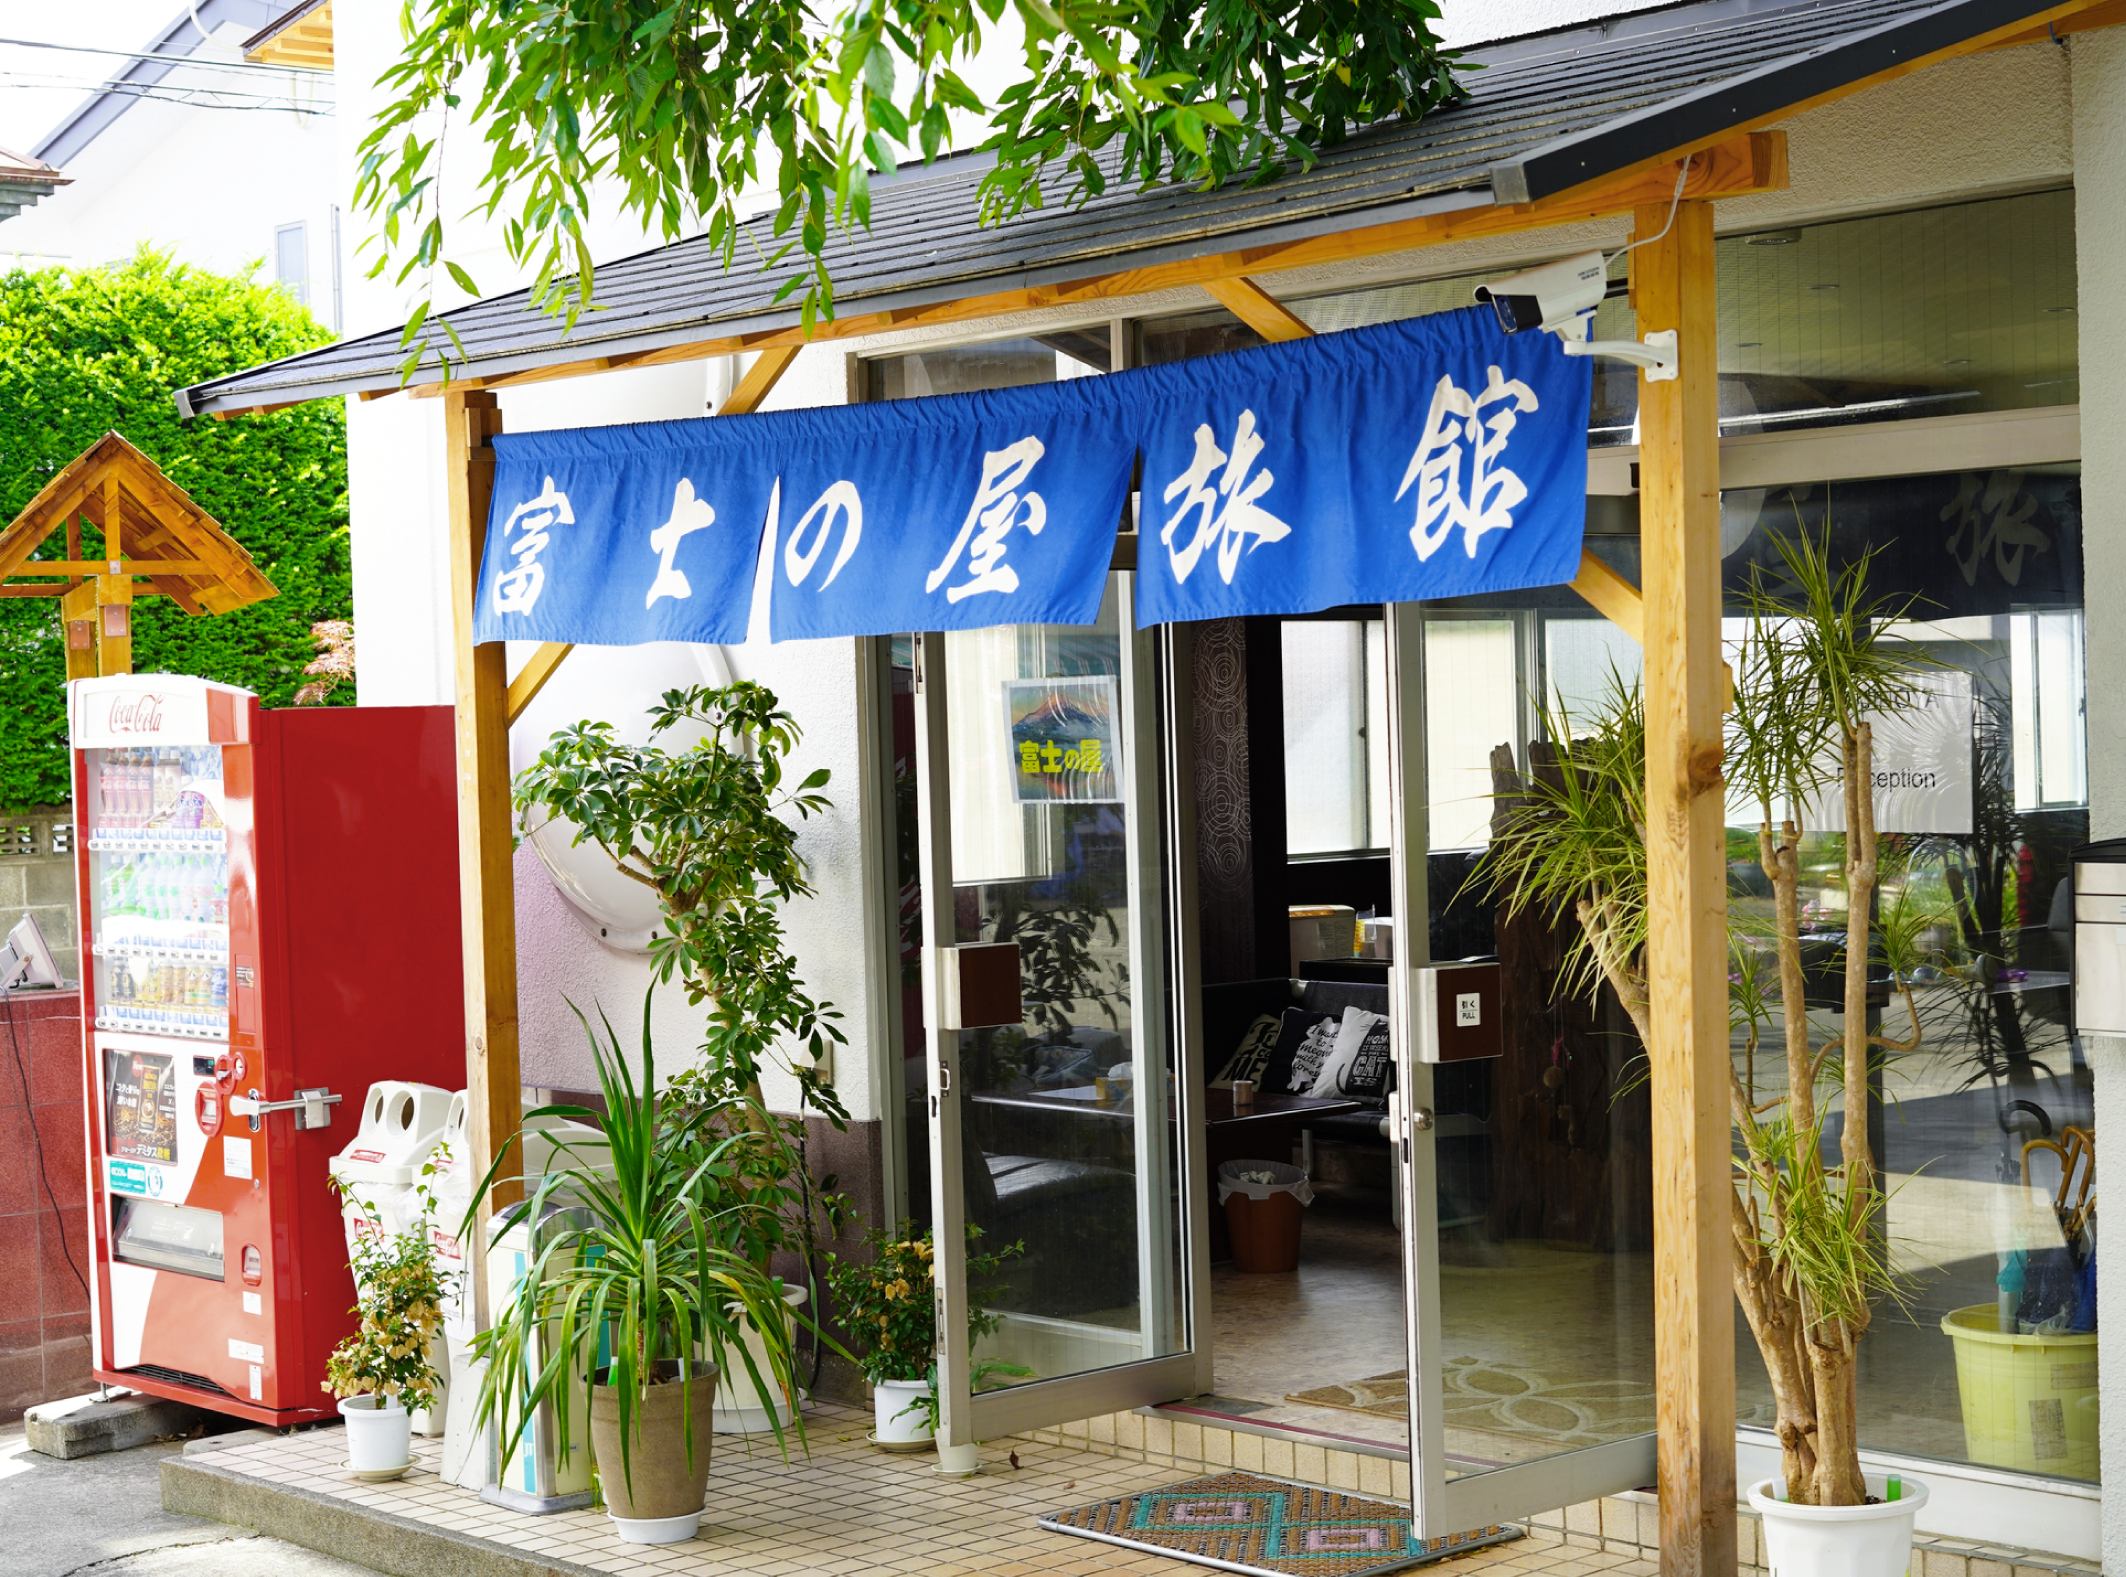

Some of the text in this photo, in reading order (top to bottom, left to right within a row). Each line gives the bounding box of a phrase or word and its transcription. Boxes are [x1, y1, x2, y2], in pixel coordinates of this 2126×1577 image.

[1019, 739, 1104, 773] 富士の屋
[1462, 1012, 1475, 1020] PULL
[1352, 1055, 1388, 1078] CAT
[523, 1442, 534, 1457] JT
